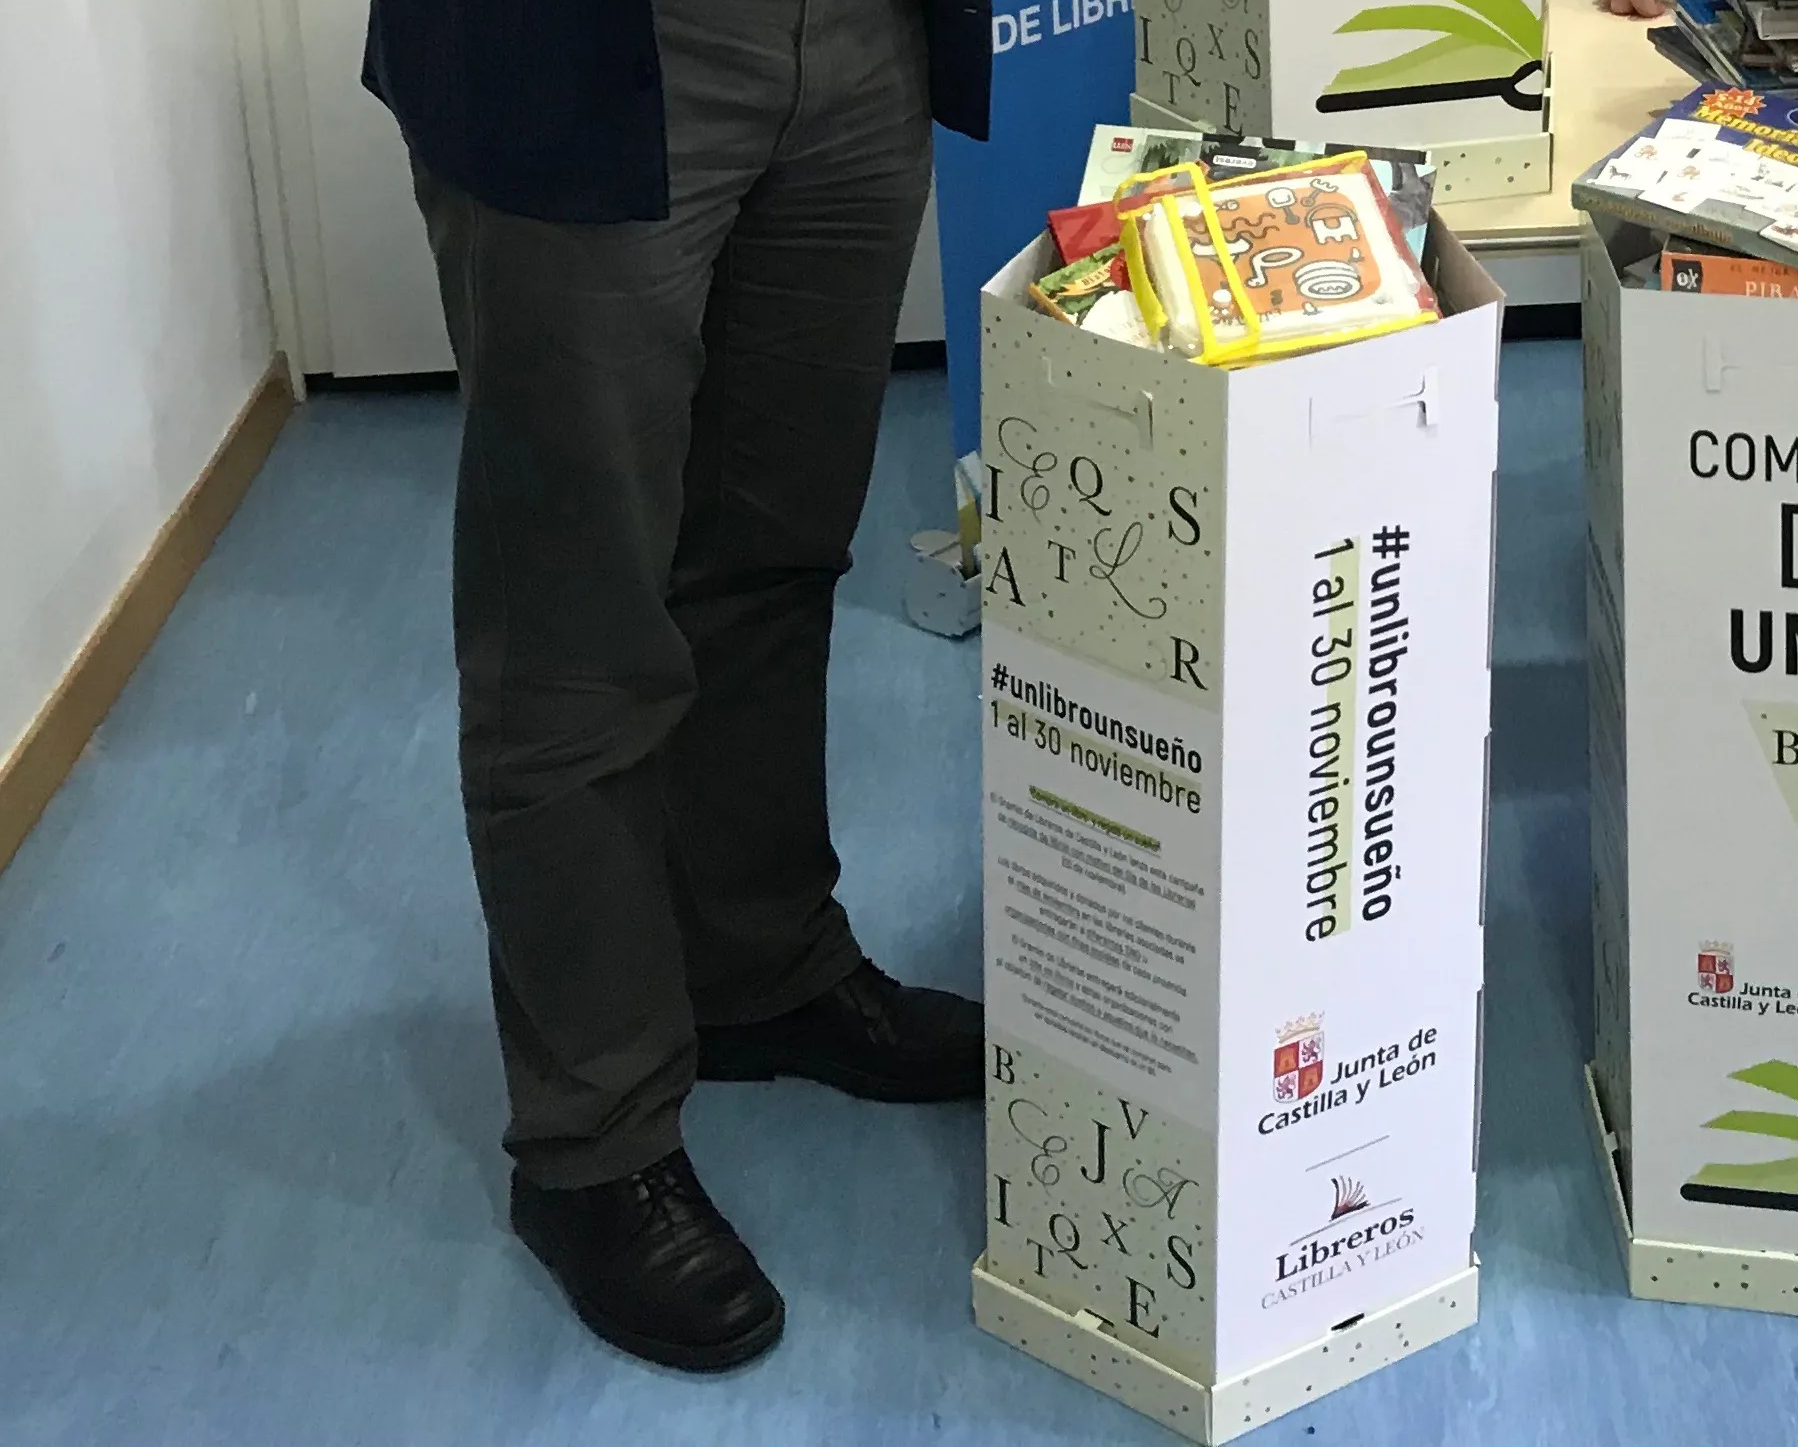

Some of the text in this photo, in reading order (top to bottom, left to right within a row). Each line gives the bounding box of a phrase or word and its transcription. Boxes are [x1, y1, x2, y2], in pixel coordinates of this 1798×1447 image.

[992, 4, 1043, 55] DE
[984, 463, 1005, 523] I
[1069, 455, 1113, 517] Q
[1168, 485, 1202, 546] S
[985, 546, 1027, 608] A
[1048, 538, 1077, 584] T
[1169, 635, 1209, 692] R
[991, 661, 1203, 775] #unlibrounsueño
[1304, 537, 1355, 944] 1 al 30 noviembre
[1362, 524, 1411, 923] #unlibrounsueño
[990, 699, 1203, 815] 1 al 30 noviembre
[1687, 992, 1754, 1013] Castilla
[1758, 1000, 1770, 1017] y
[1738, 981, 1793, 1002] Junta
[992, 1043, 1016, 1086] B
[1329, 1026, 1438, 1085] Junta de
[1117, 1098, 1150, 1141] V
[1257, 1048, 1437, 1137] Castilla y León
[1080, 1118, 1112, 1185] J
[993, 1173, 1013, 1227] I
[1026, 1237, 1054, 1279] T
[1047, 1212, 1089, 1270] Q
[1100, 1211, 1132, 1254] X
[1275, 1207, 1415, 1283] Libreros
[1166, 1234, 1197, 1291] S
[1260, 1225, 1426, 1311] CASTILLA Y LEÓN
[1126, 1275, 1161, 1339] E
